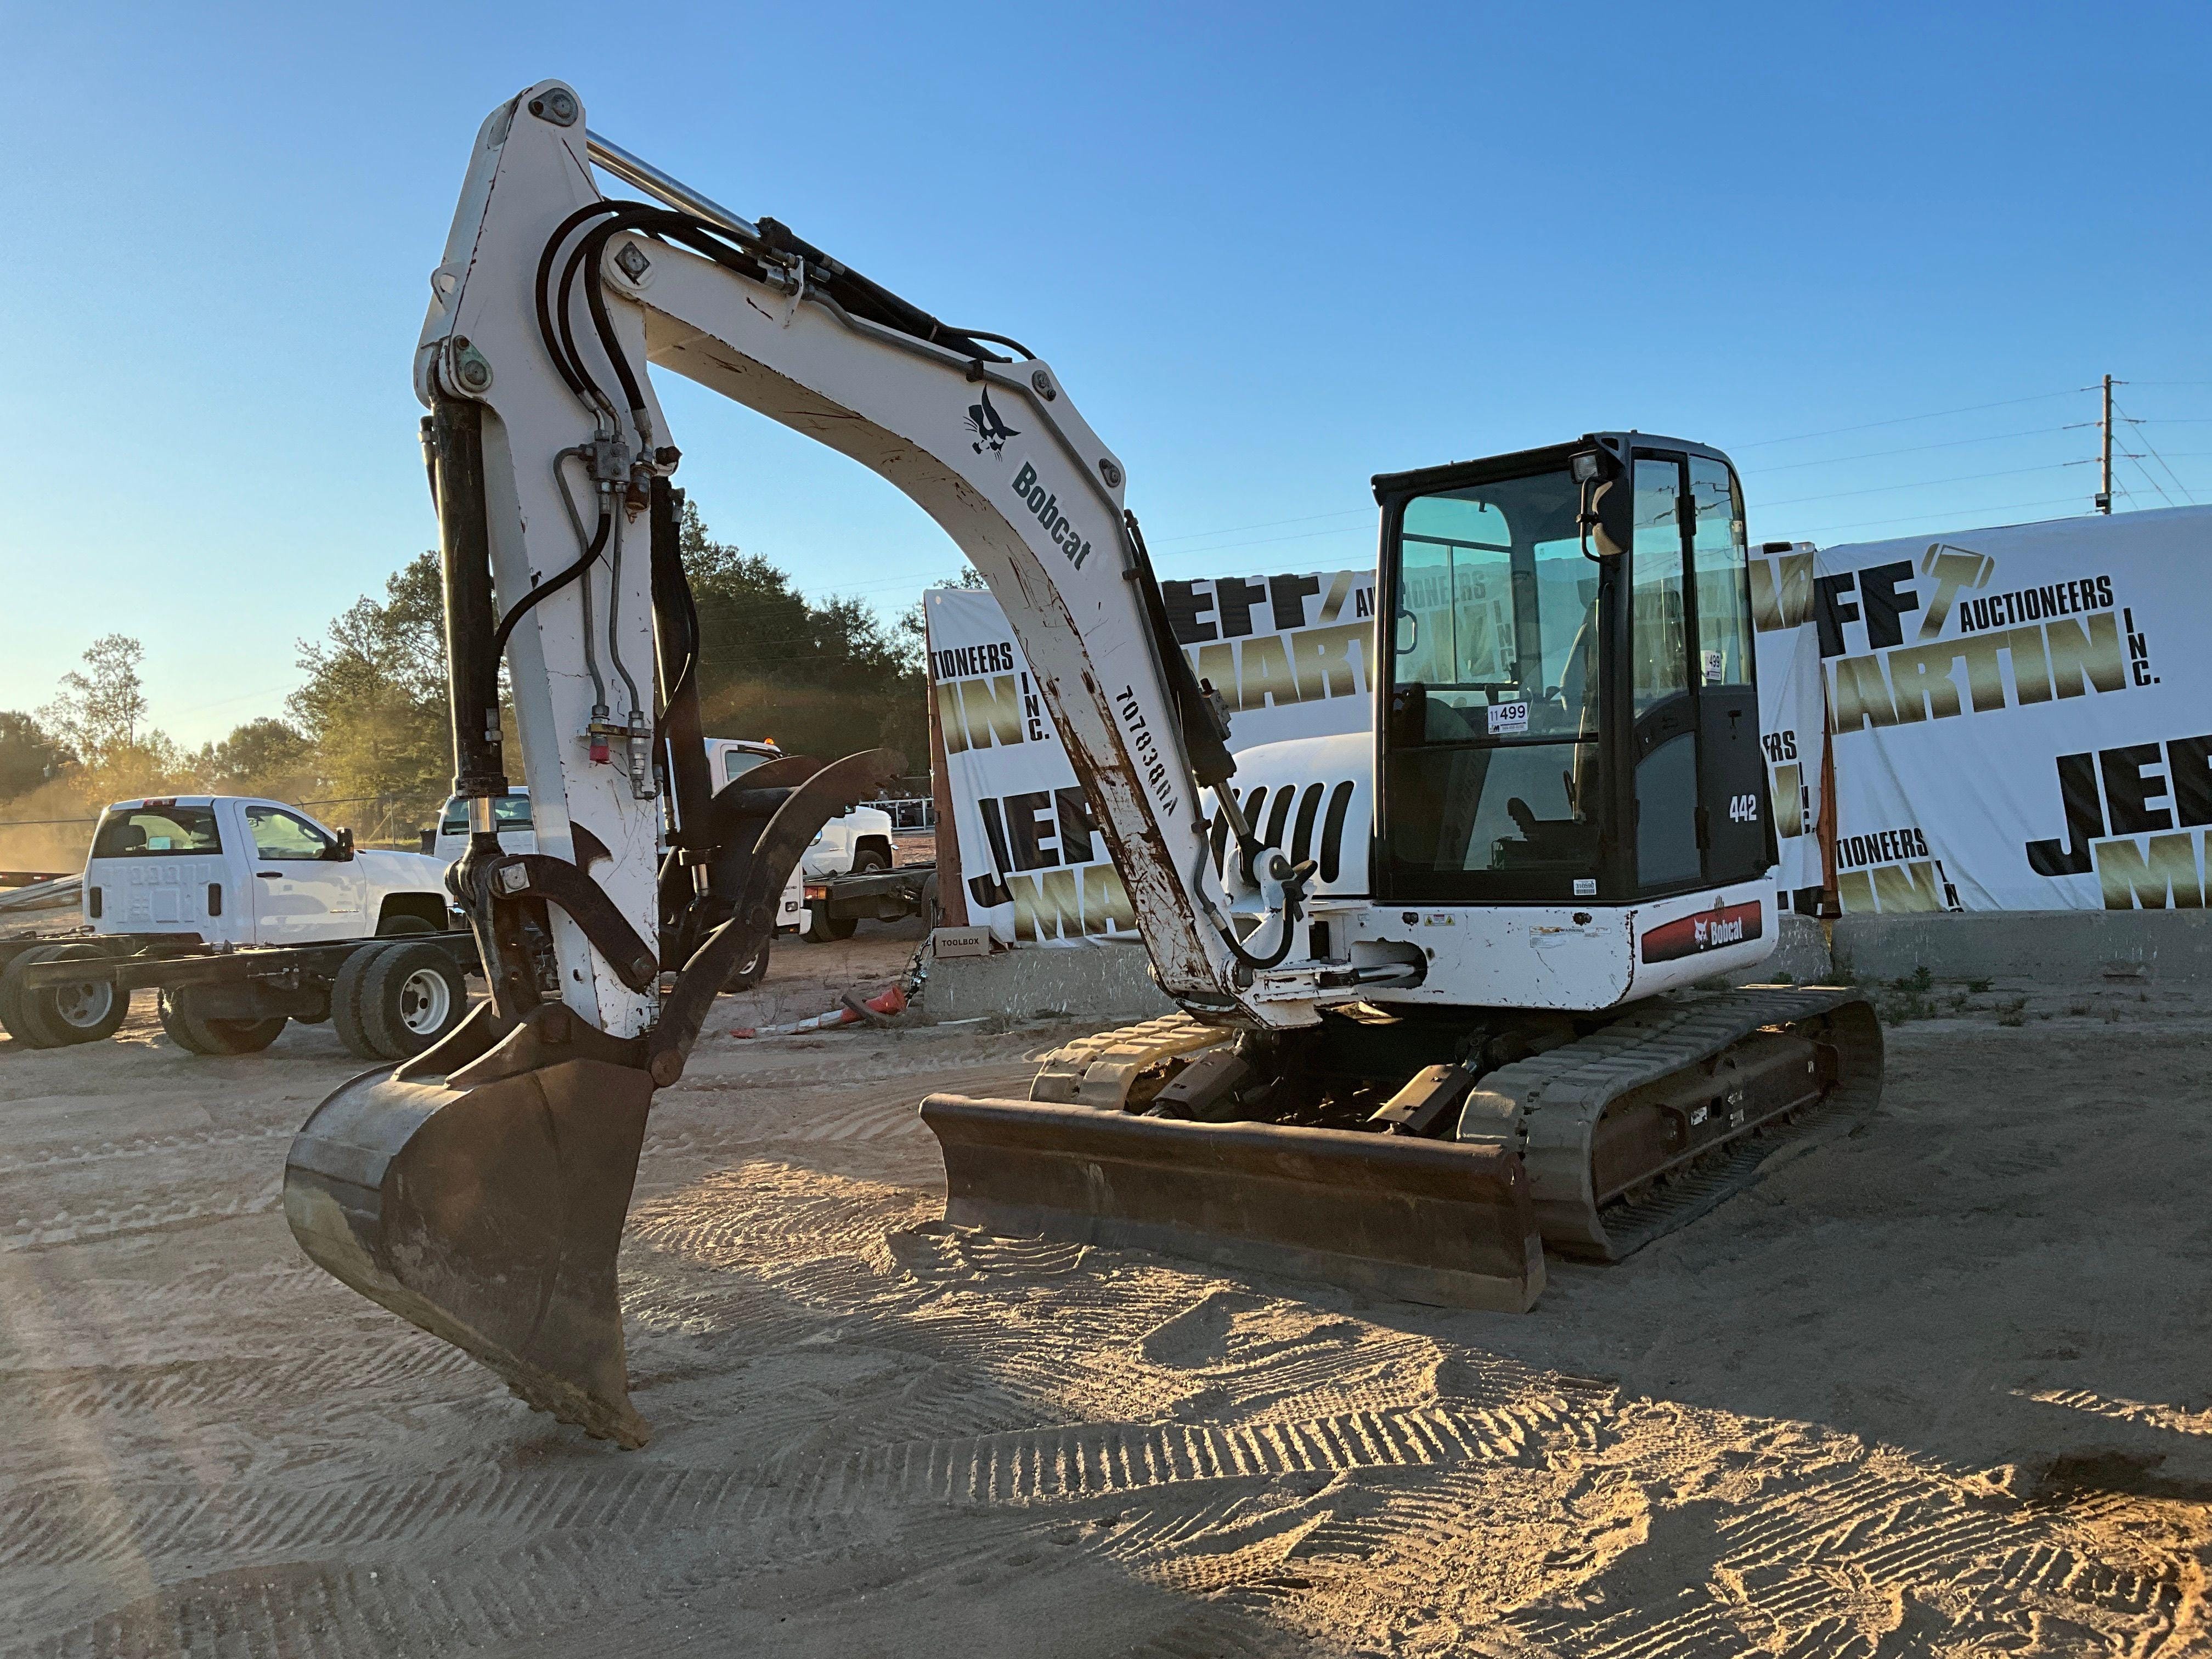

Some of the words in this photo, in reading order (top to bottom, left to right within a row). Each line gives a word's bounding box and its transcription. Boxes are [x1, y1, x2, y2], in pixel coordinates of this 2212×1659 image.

[1012, 461, 1091, 571] Bobcat
[1960, 575, 2113, 633] AUCTIONEERS
[1821, 611, 2126, 735] ARTIN
[2123, 607, 2160, 686] INC.
[1020, 672, 1049, 741] INC.
[1729, 794, 1757, 822] 442
[942, 938, 979, 947] TOOLBOX
[1711, 916, 1742, 945] Bobcat
